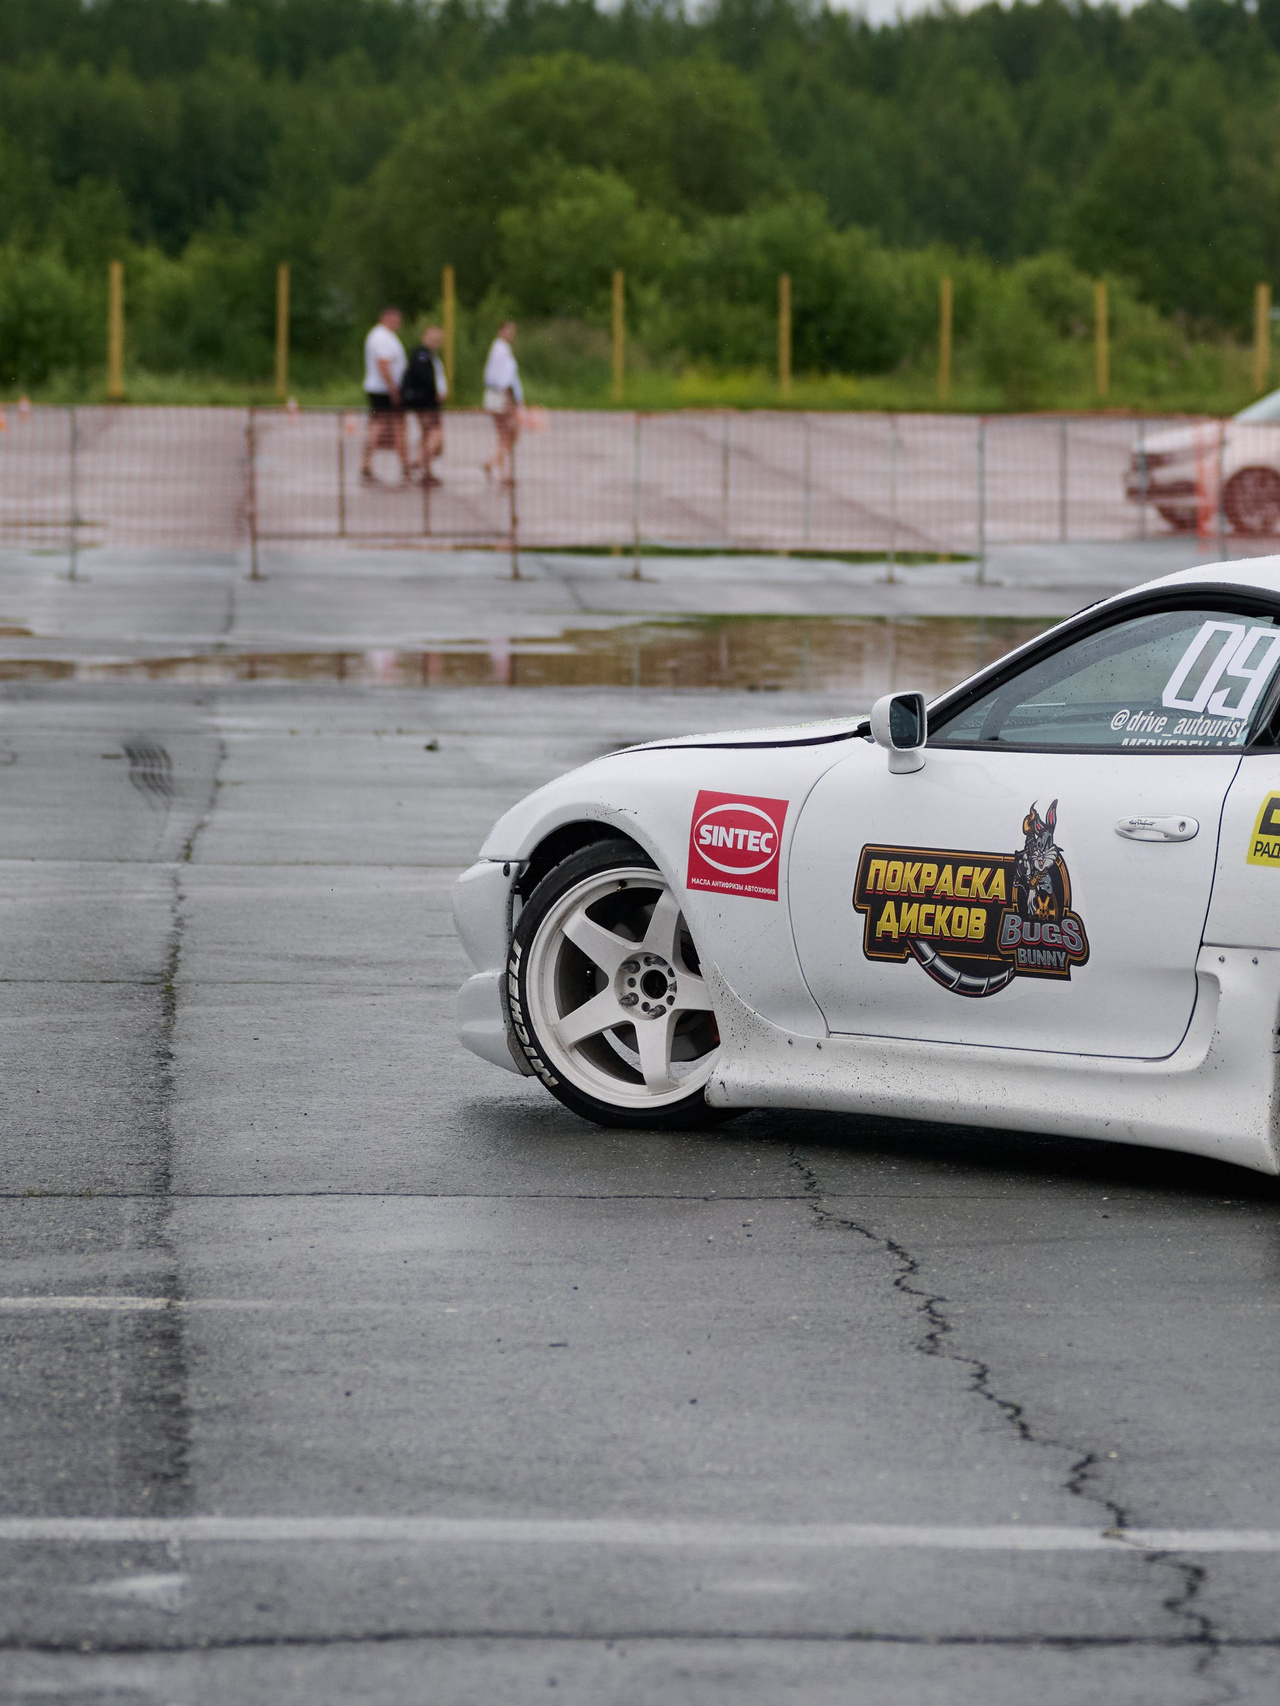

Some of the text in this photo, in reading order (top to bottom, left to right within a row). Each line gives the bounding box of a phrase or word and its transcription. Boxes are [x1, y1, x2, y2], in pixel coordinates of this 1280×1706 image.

[699, 824, 773, 854] SINTEC
[865, 859, 1006, 903] ПОКРАСКА
[875, 901, 987, 941] ДИСКОВ
[1000, 914, 1084, 955] BUGS
[1017, 948, 1067, 969] BUNNY
